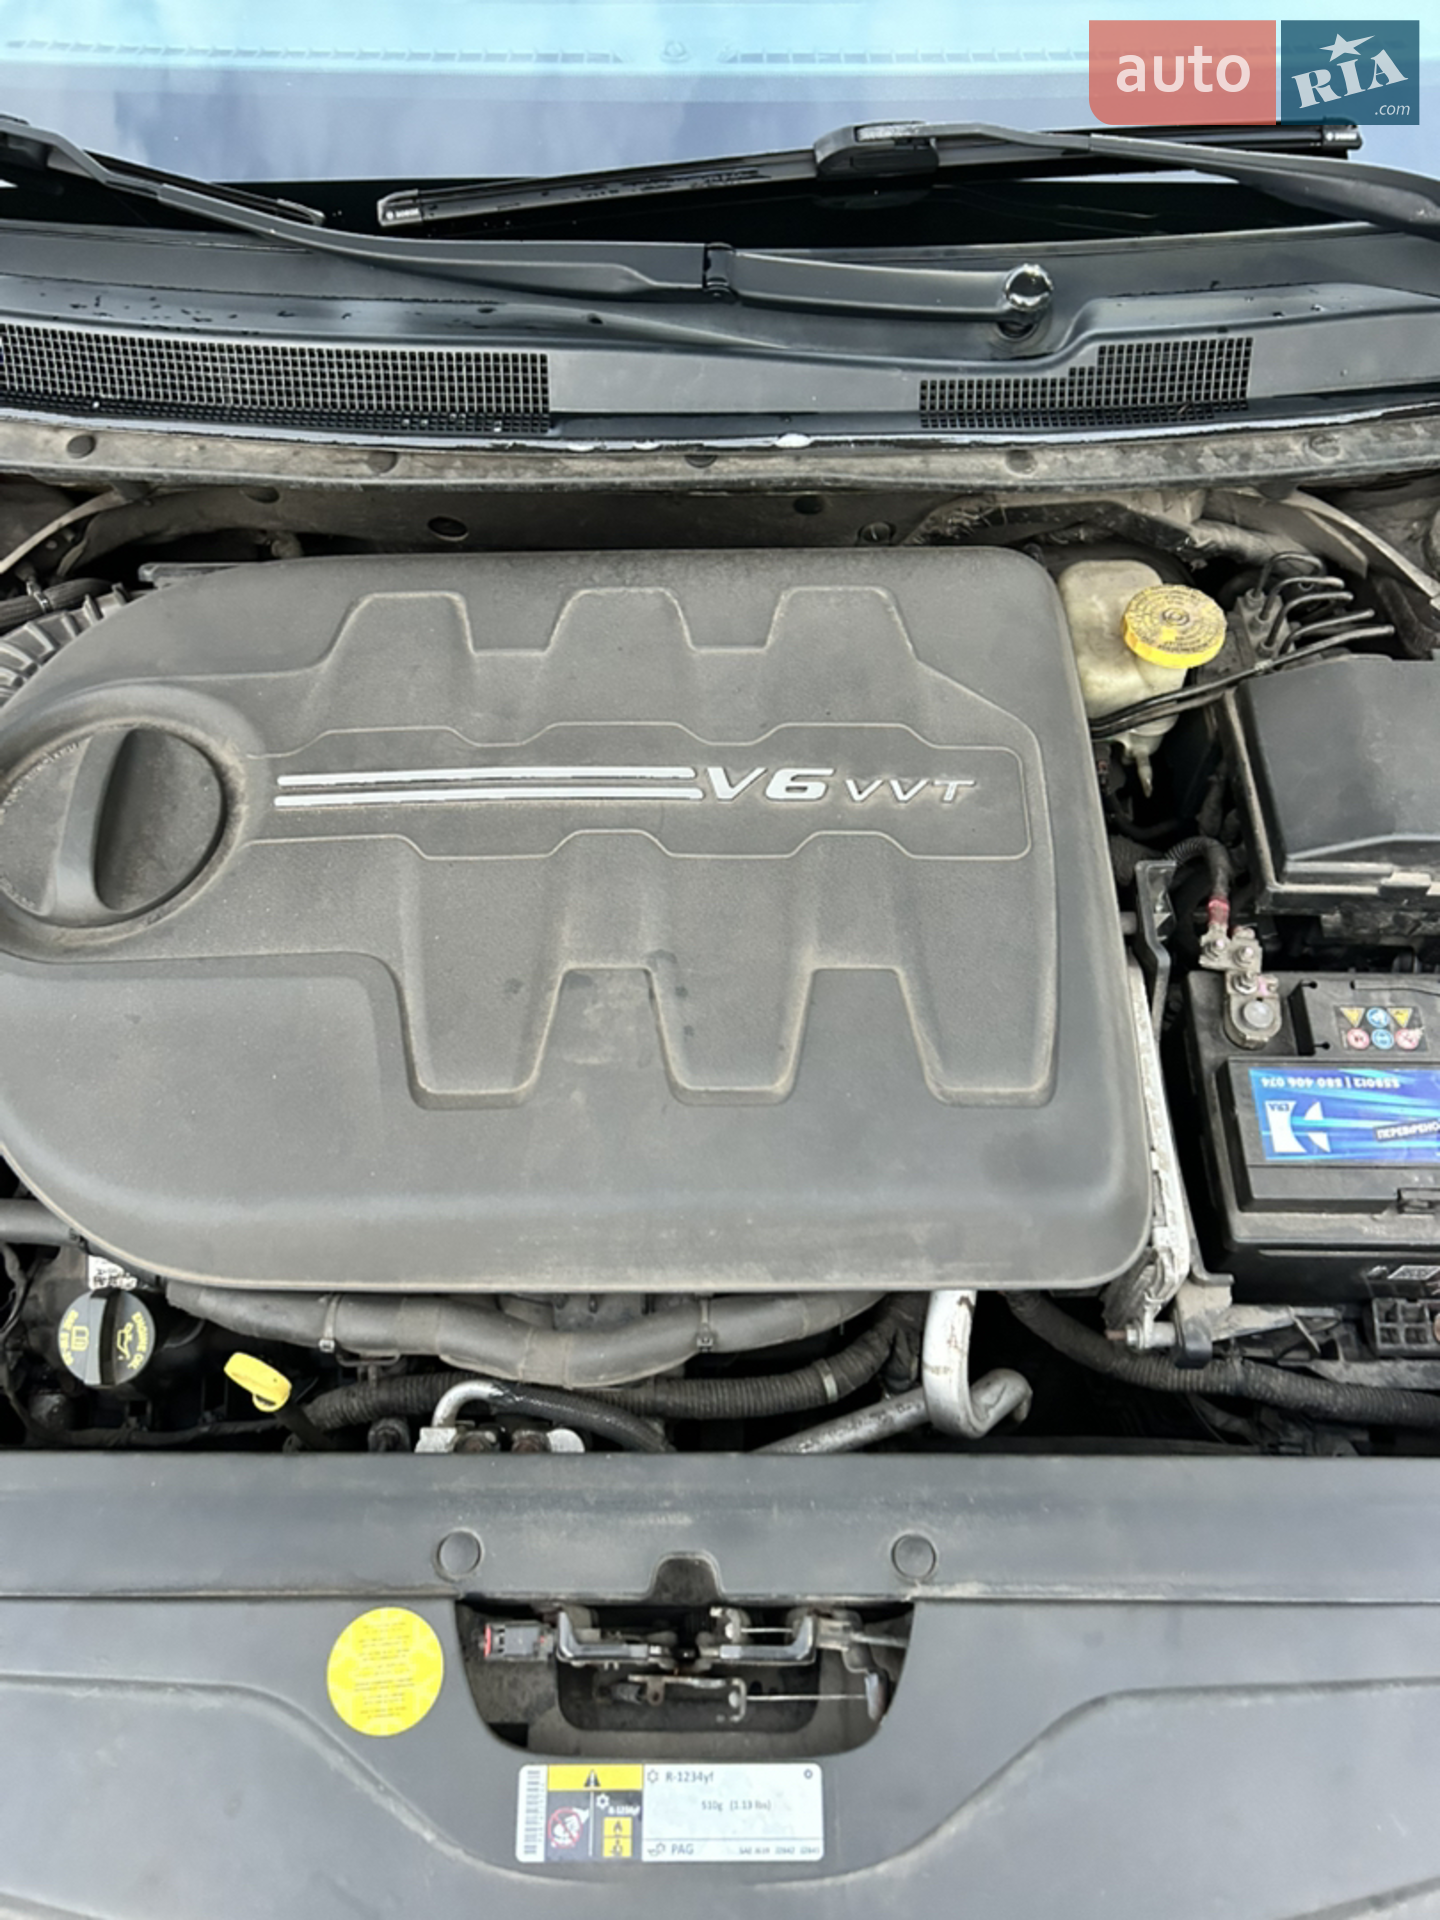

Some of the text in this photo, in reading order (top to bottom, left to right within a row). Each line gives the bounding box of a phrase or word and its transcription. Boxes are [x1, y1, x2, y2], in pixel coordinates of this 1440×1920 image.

[706, 766, 977, 802] V6 VVT
[671, 1843, 694, 1855] PAG
